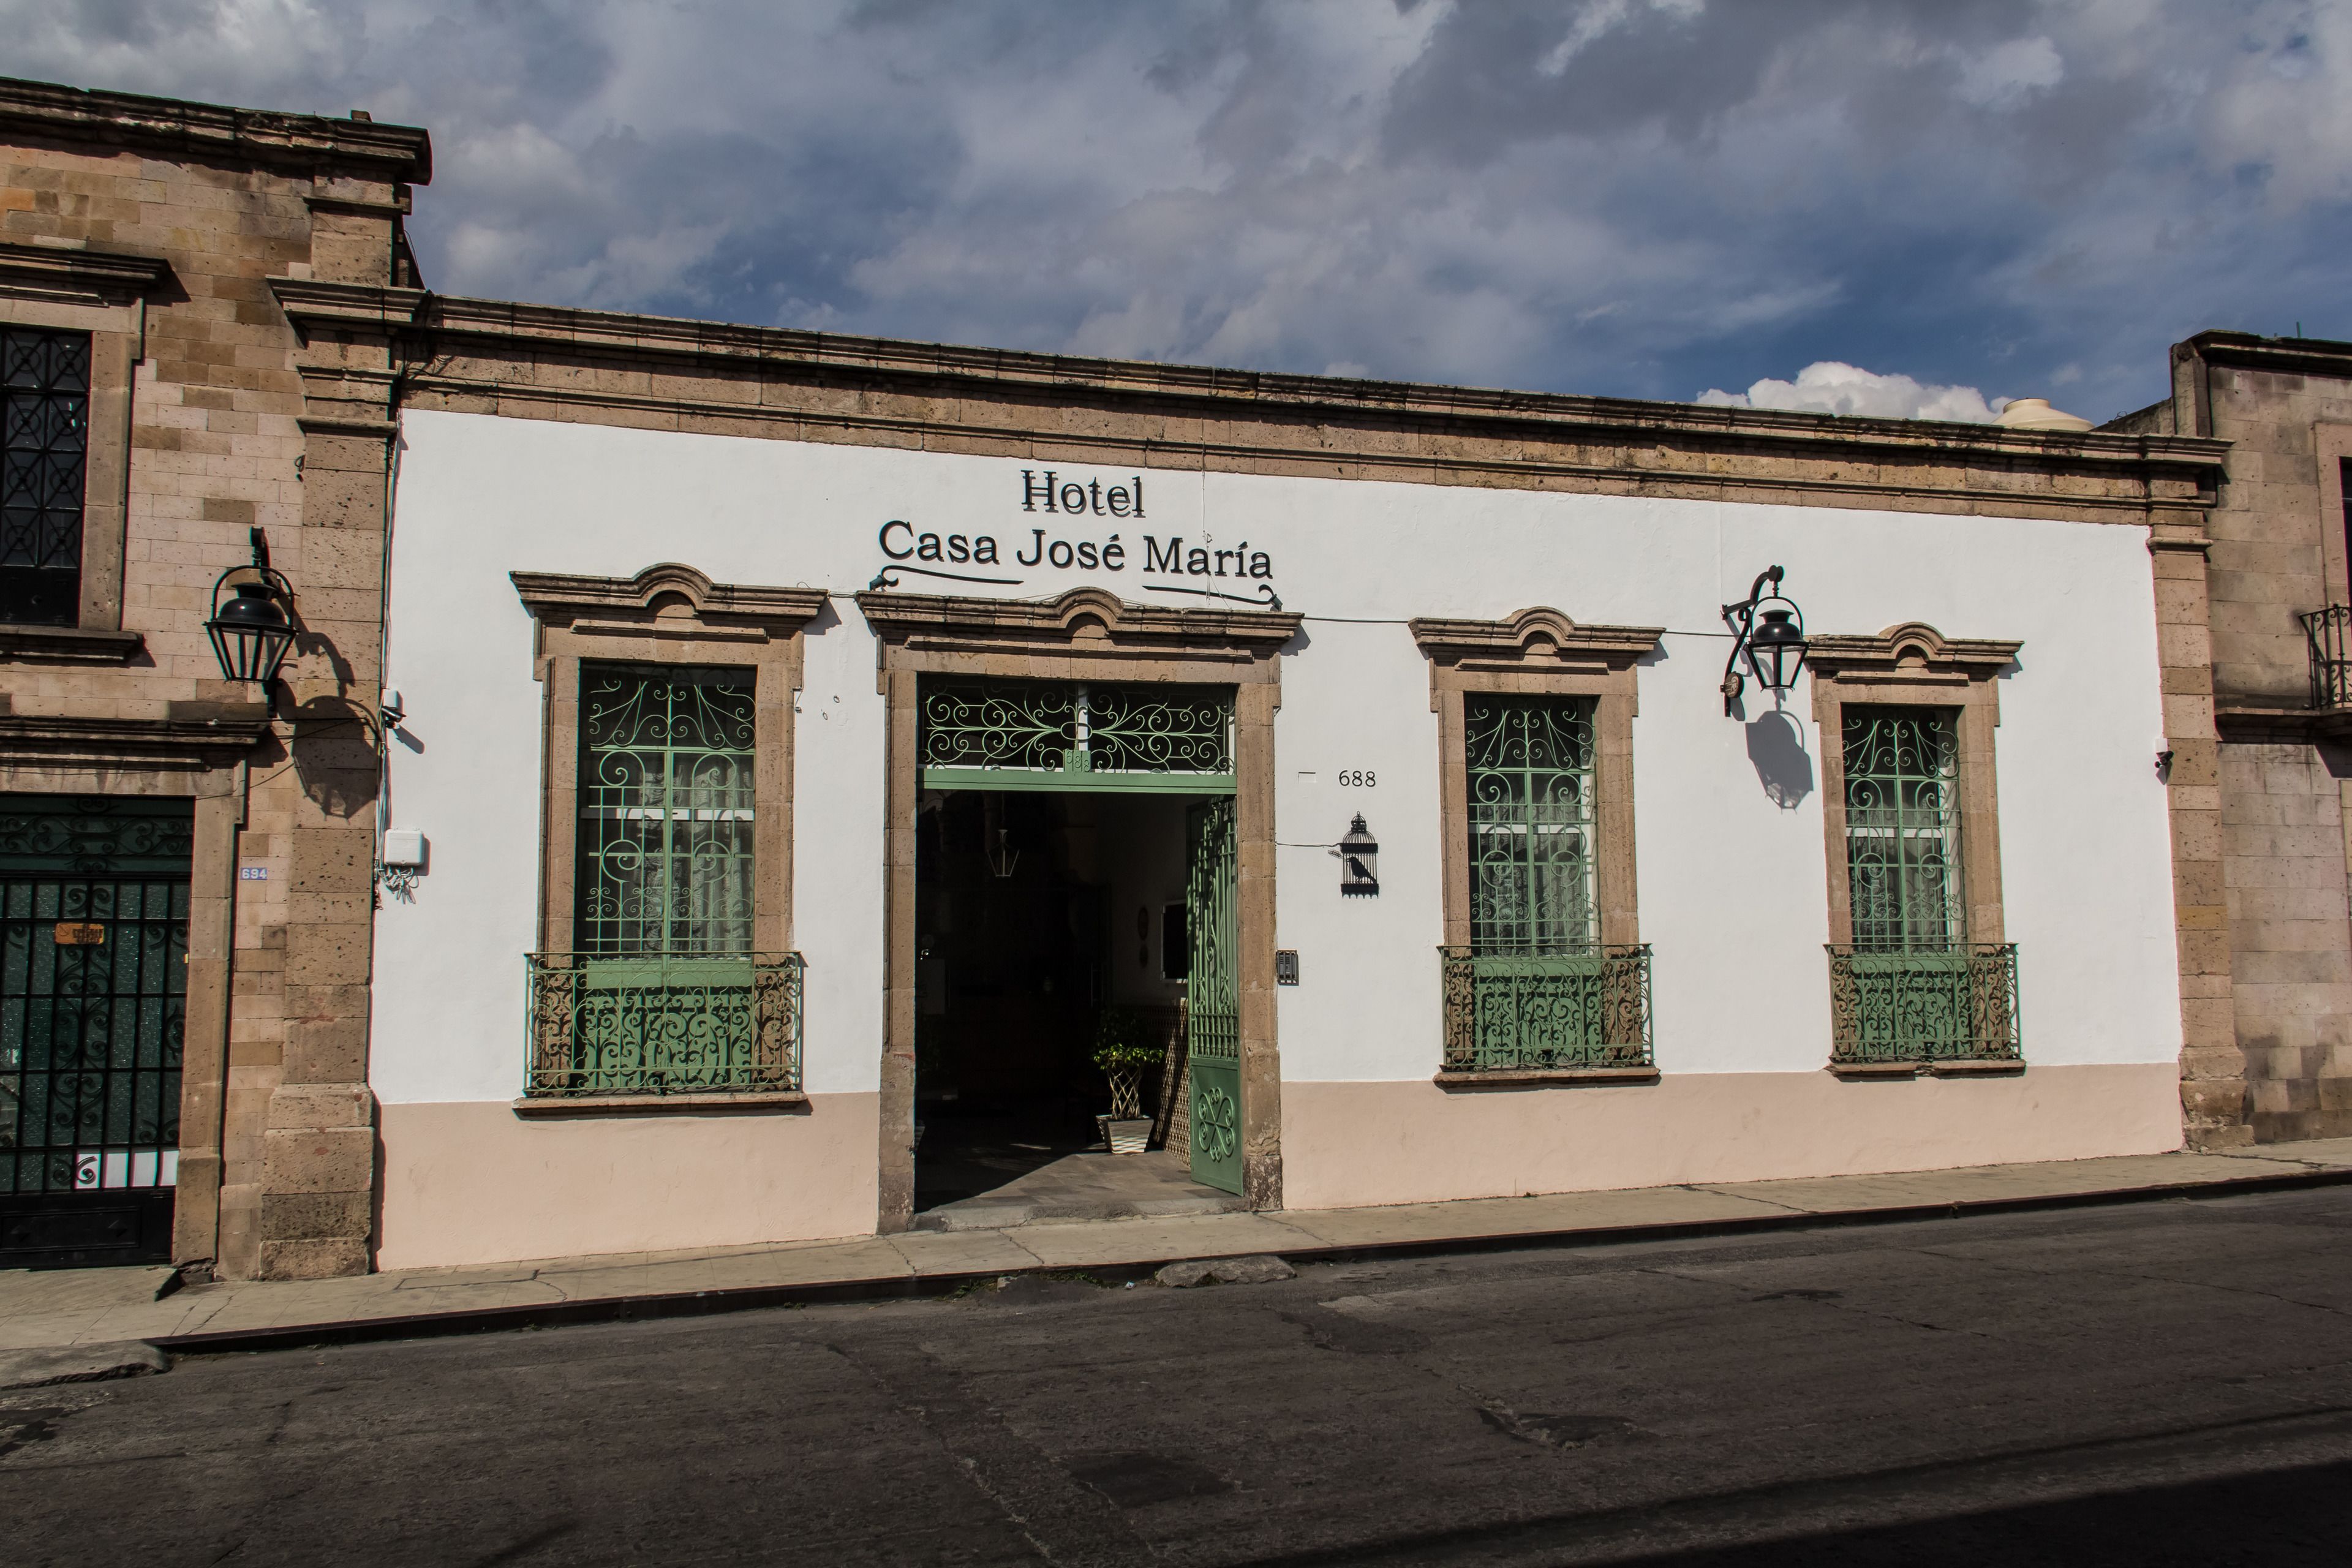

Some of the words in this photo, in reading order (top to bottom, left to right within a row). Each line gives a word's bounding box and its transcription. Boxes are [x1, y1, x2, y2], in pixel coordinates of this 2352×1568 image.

[1021, 470, 1145, 516] Hotel
[879, 520, 1000, 564] Casa
[1017, 529, 1125, 570] José
[1143, 535, 1273, 578] María
[1339, 770, 1376, 787] 688
[242, 869, 267, 880] 694
